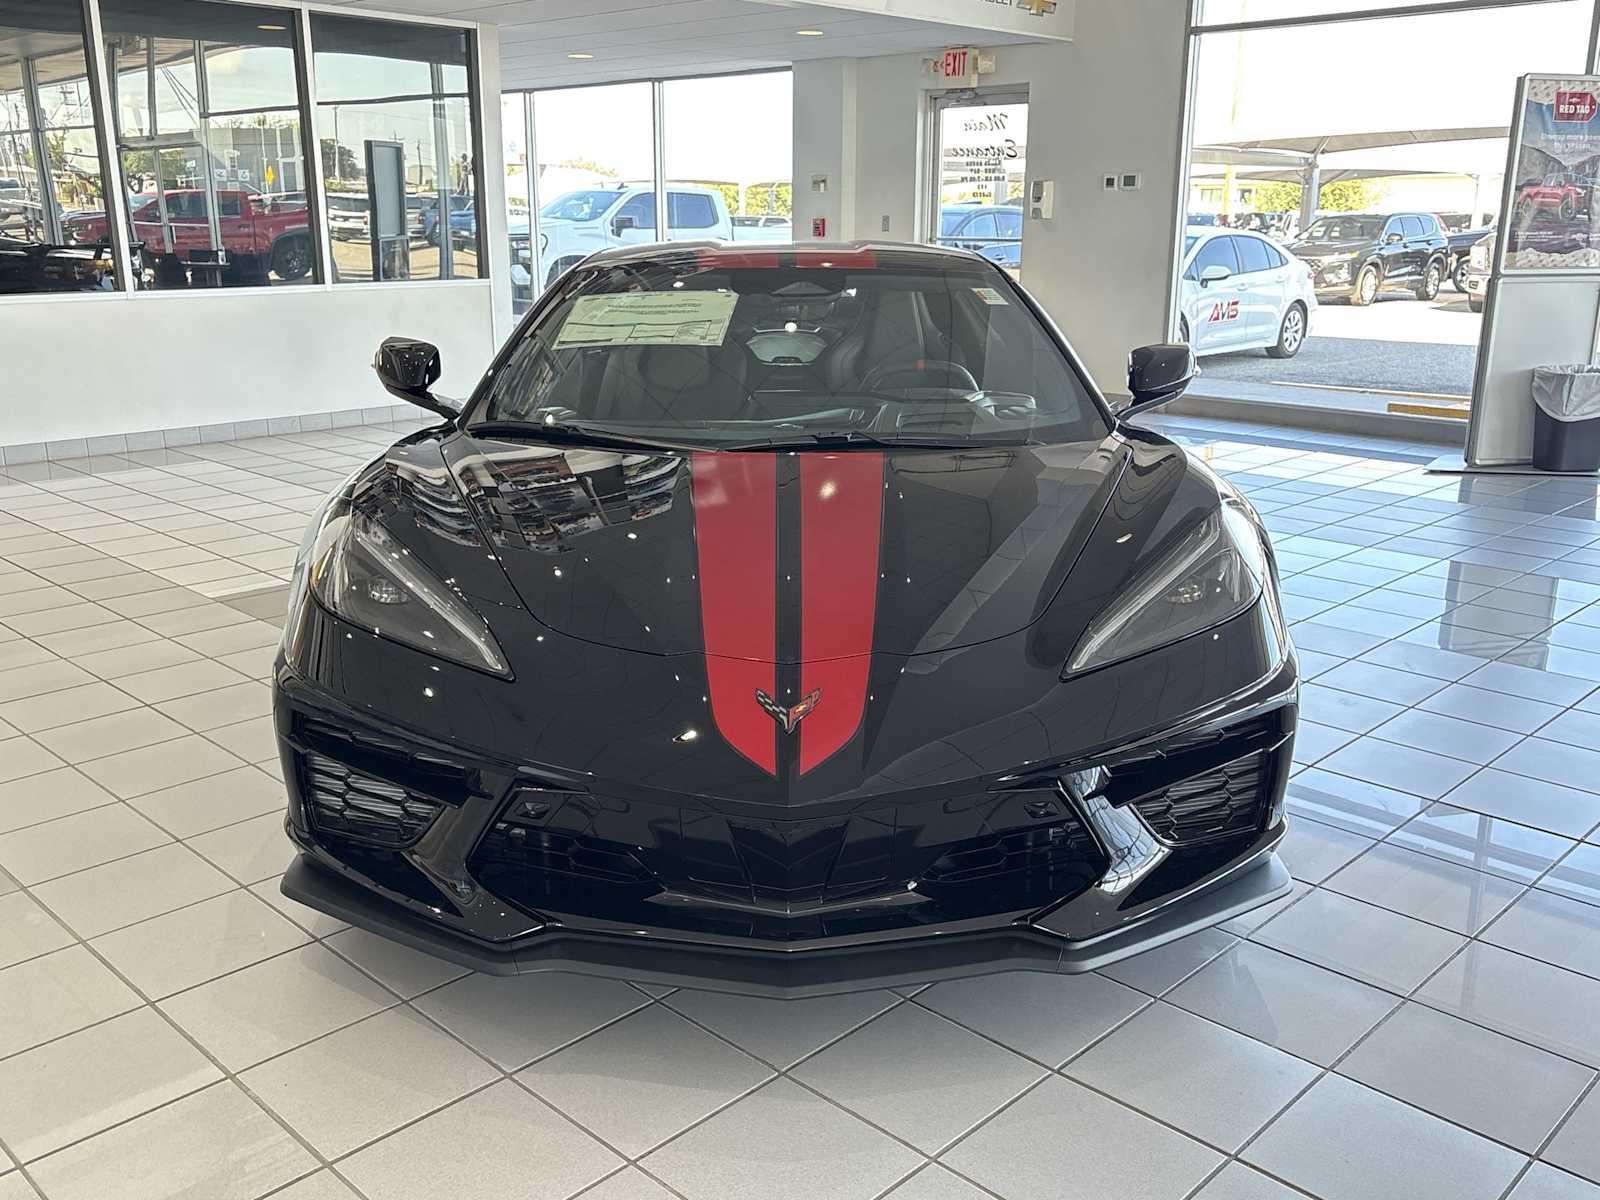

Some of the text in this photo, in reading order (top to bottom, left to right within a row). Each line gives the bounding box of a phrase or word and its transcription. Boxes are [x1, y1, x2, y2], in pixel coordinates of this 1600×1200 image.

[945, 51, 968, 76] EXIT
[1559, 104, 1590, 114] RED TAG
